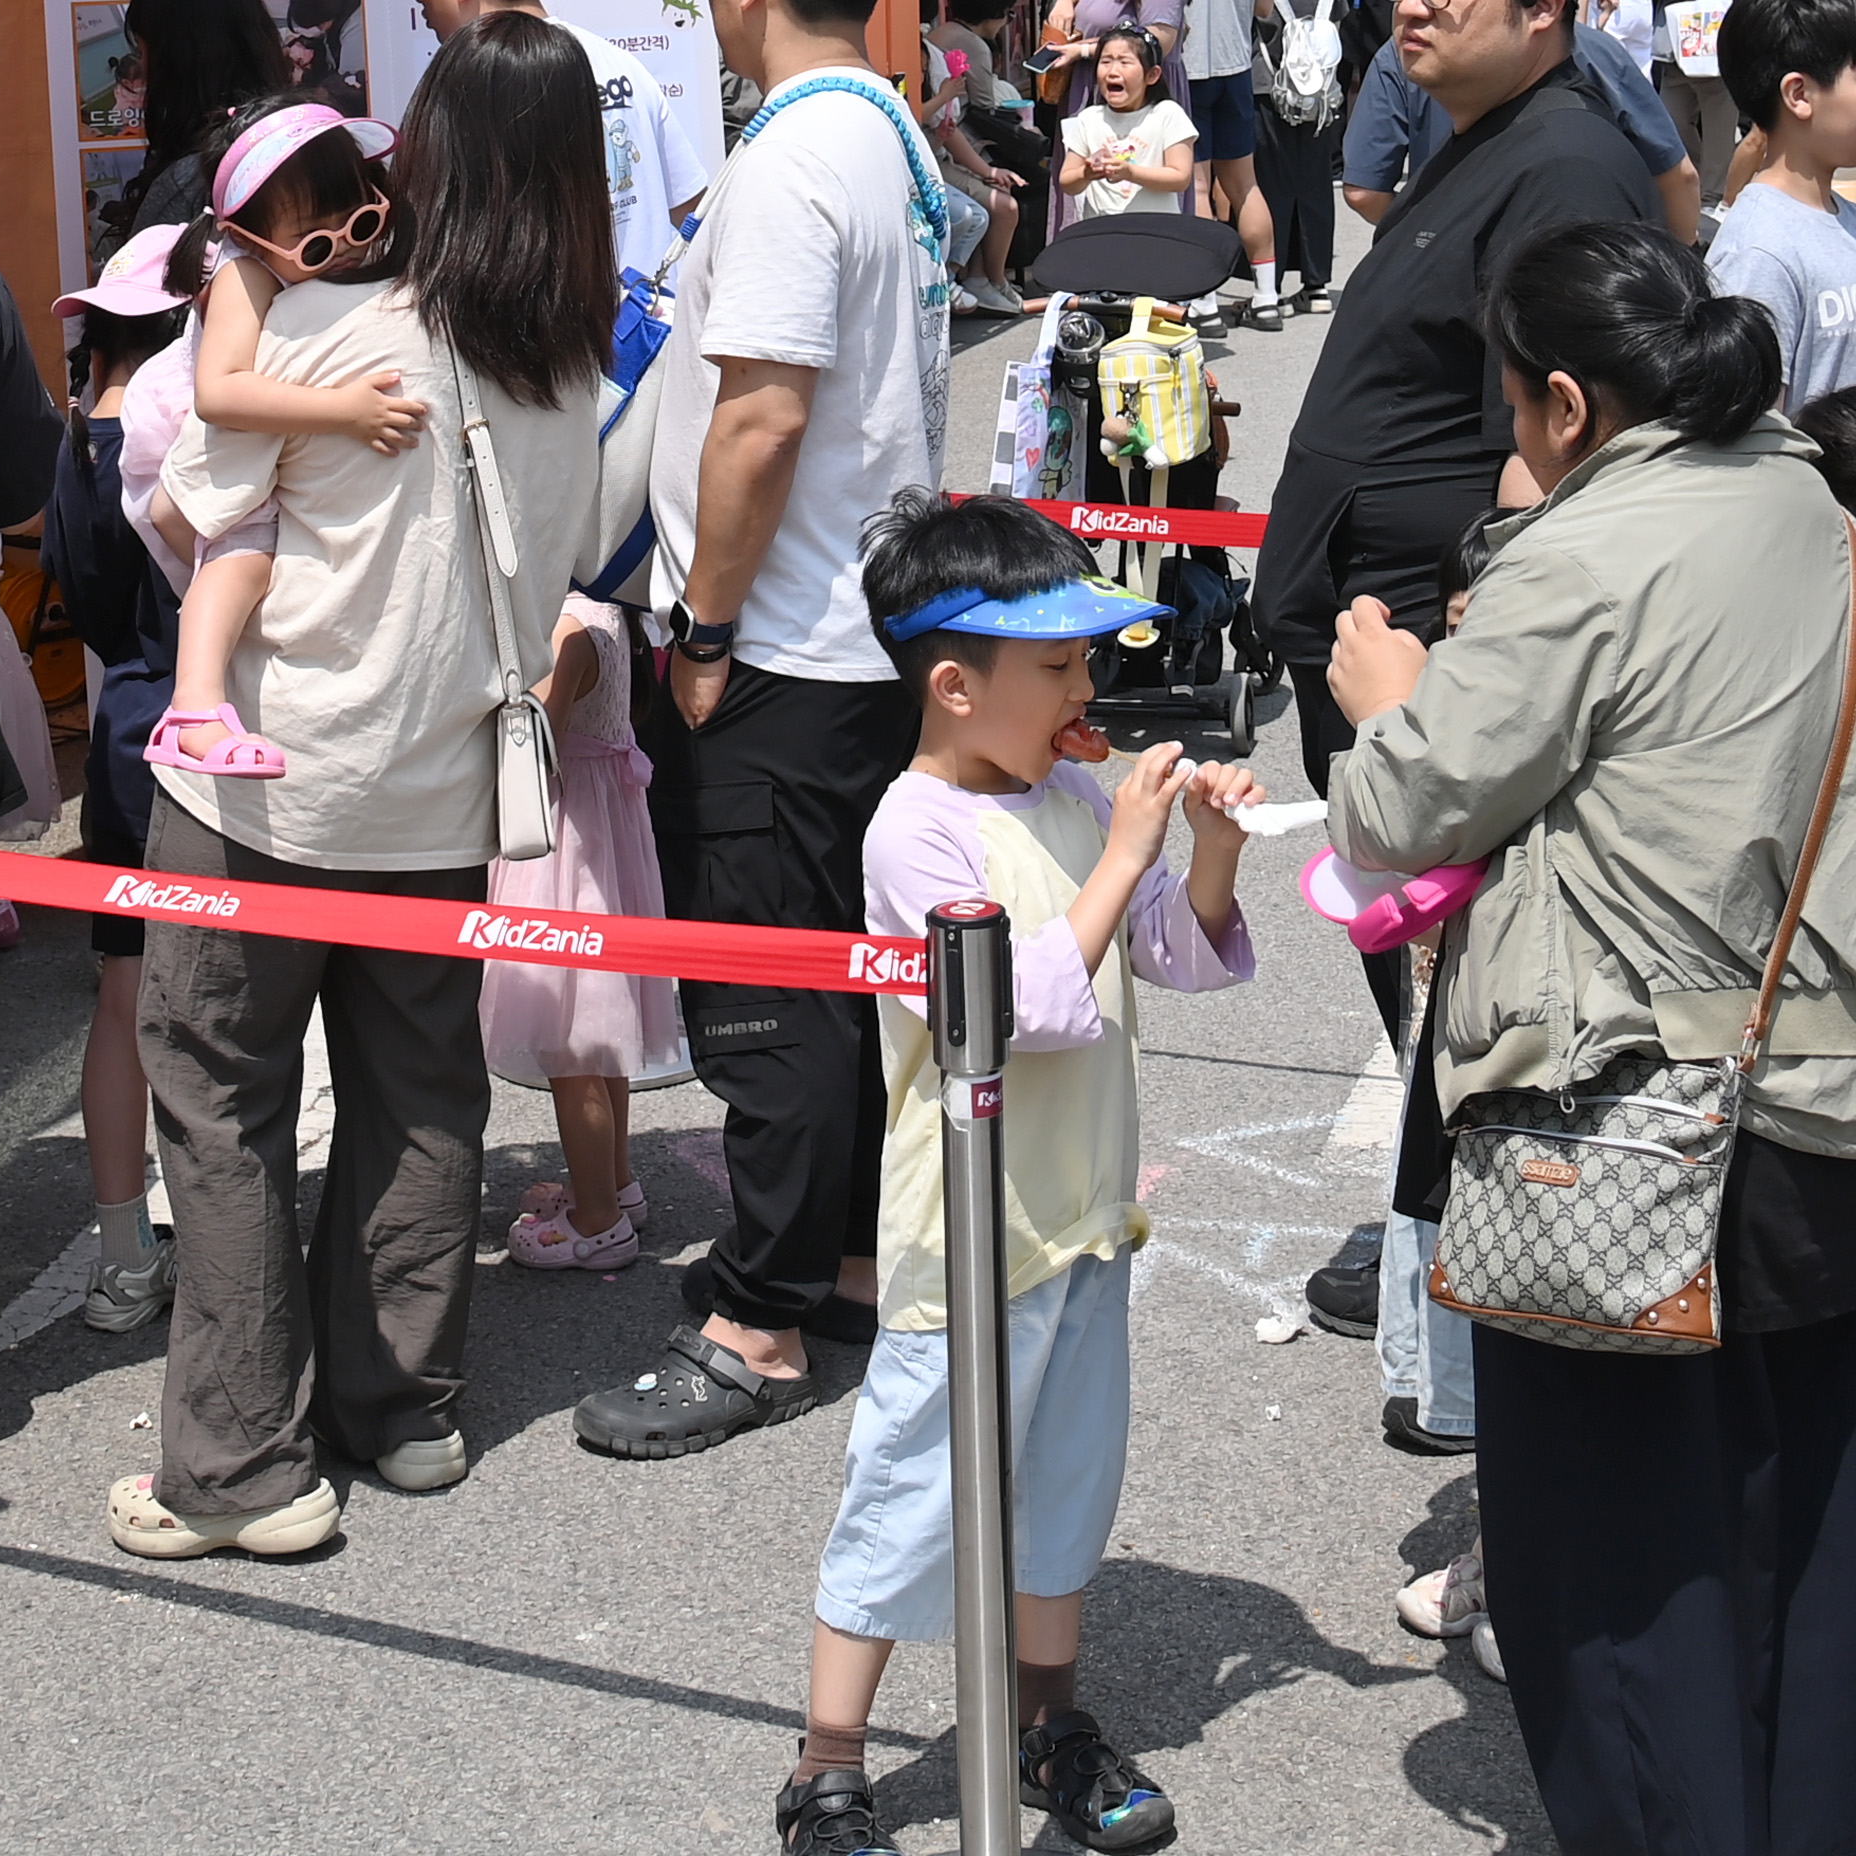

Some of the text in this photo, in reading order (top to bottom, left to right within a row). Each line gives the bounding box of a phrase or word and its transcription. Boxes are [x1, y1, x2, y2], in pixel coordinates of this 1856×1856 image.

[89, 107, 145, 128] 드로잉
[1071, 506, 1169, 535] KidZania
[103, 874, 241, 917] KidZania
[458, 910, 604, 957] KidZania
[705, 1019, 778, 1036] UMBRO
